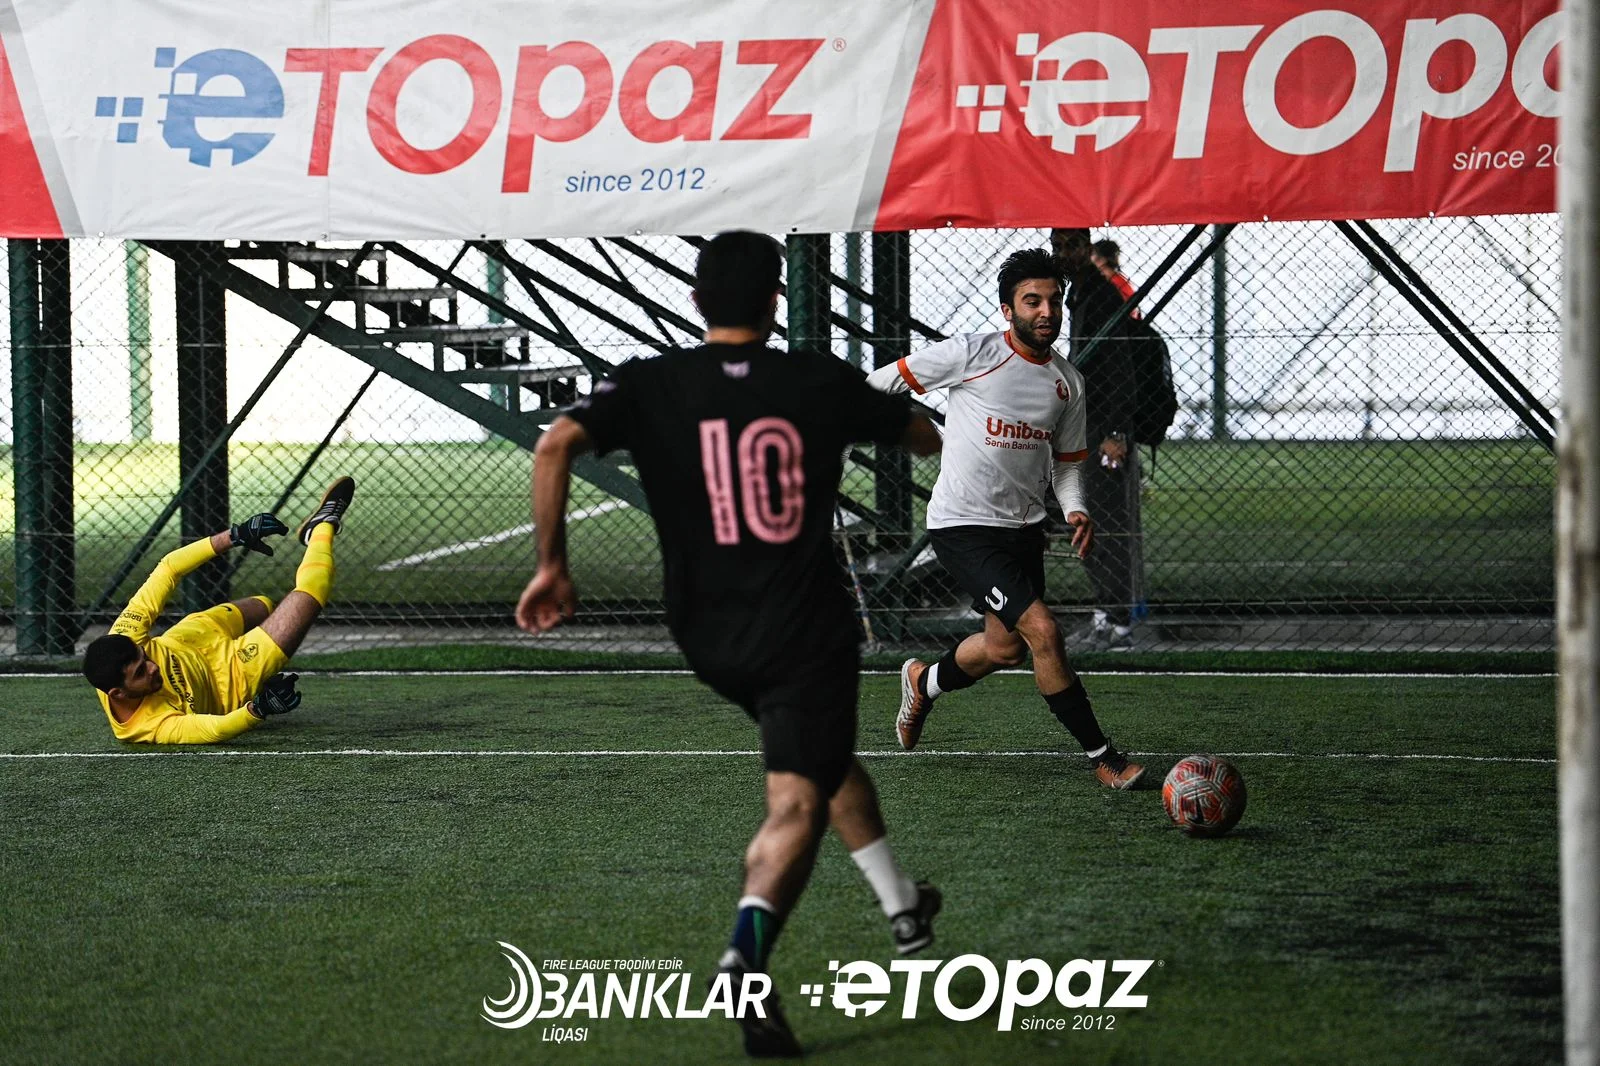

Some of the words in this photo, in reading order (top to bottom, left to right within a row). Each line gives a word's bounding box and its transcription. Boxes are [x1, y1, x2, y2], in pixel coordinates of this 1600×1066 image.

[1453, 145, 1526, 171] since
[565, 169, 632, 193] since
[640, 167, 706, 192] 2012
[699, 416, 805, 545] 10
